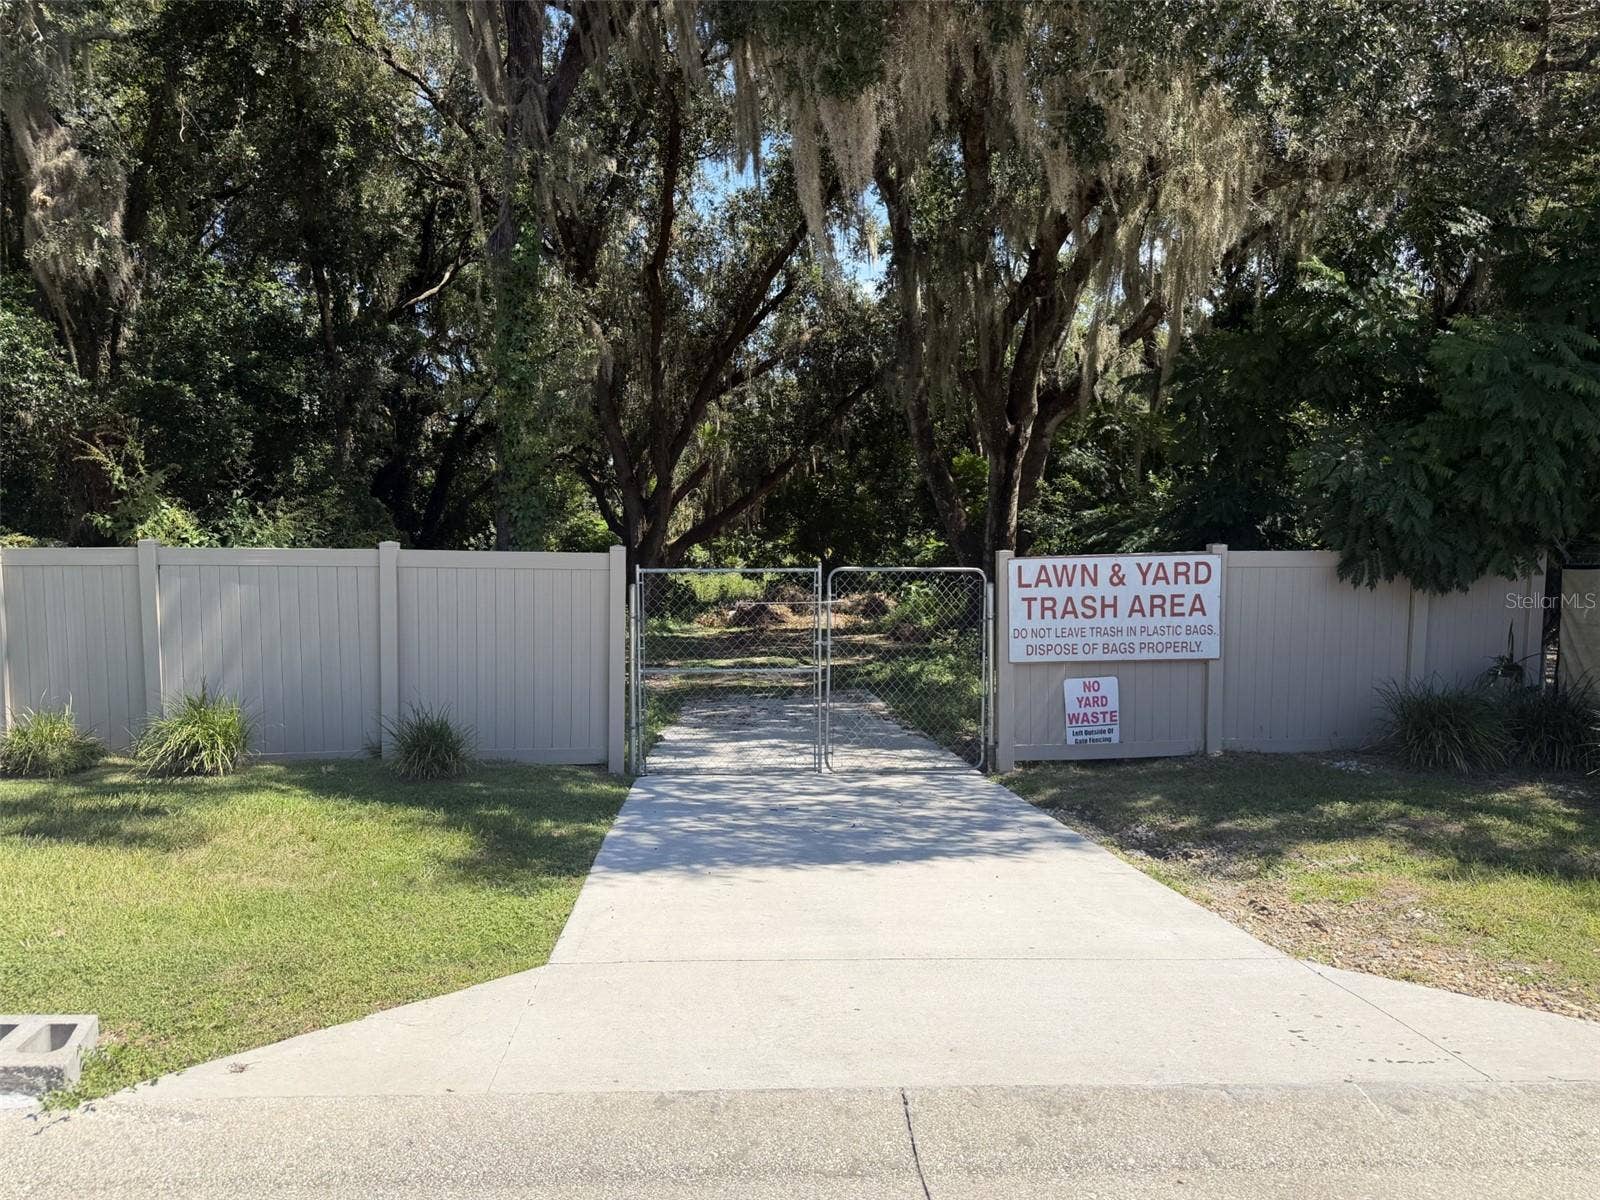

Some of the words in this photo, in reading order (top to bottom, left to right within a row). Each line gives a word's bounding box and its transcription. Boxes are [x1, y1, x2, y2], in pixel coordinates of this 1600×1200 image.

[1017, 563, 1099, 588] LAWN
[1108, 563, 1127, 587] &
[1136, 561, 1212, 586] YARD
[1021, 595, 1118, 620] TRASH
[1127, 593, 1207, 619] AREA
[1013, 627, 1028, 639] DO
[1031, 627, 1052, 639] NOT
[1055, 626, 1086, 638] LEAVE
[1089, 626, 1123, 638] TRASH
[1126, 625, 1137, 637] IN
[1140, 624, 1182, 637] PLASTIC
[1185, 624, 1217, 636] BAGS.
[1026, 643, 1078, 656] DISPOSE
[1082, 643, 1098, 655] OF
[1102, 642, 1135, 655] BAGS
[1139, 641, 1204, 654] PROPERLY.
[1083, 680, 1100, 693] NO
[1076, 695, 1108, 708] YARD
[1067, 711, 1118, 725] WASTE
[1084, 728, 1106, 736] Outside
